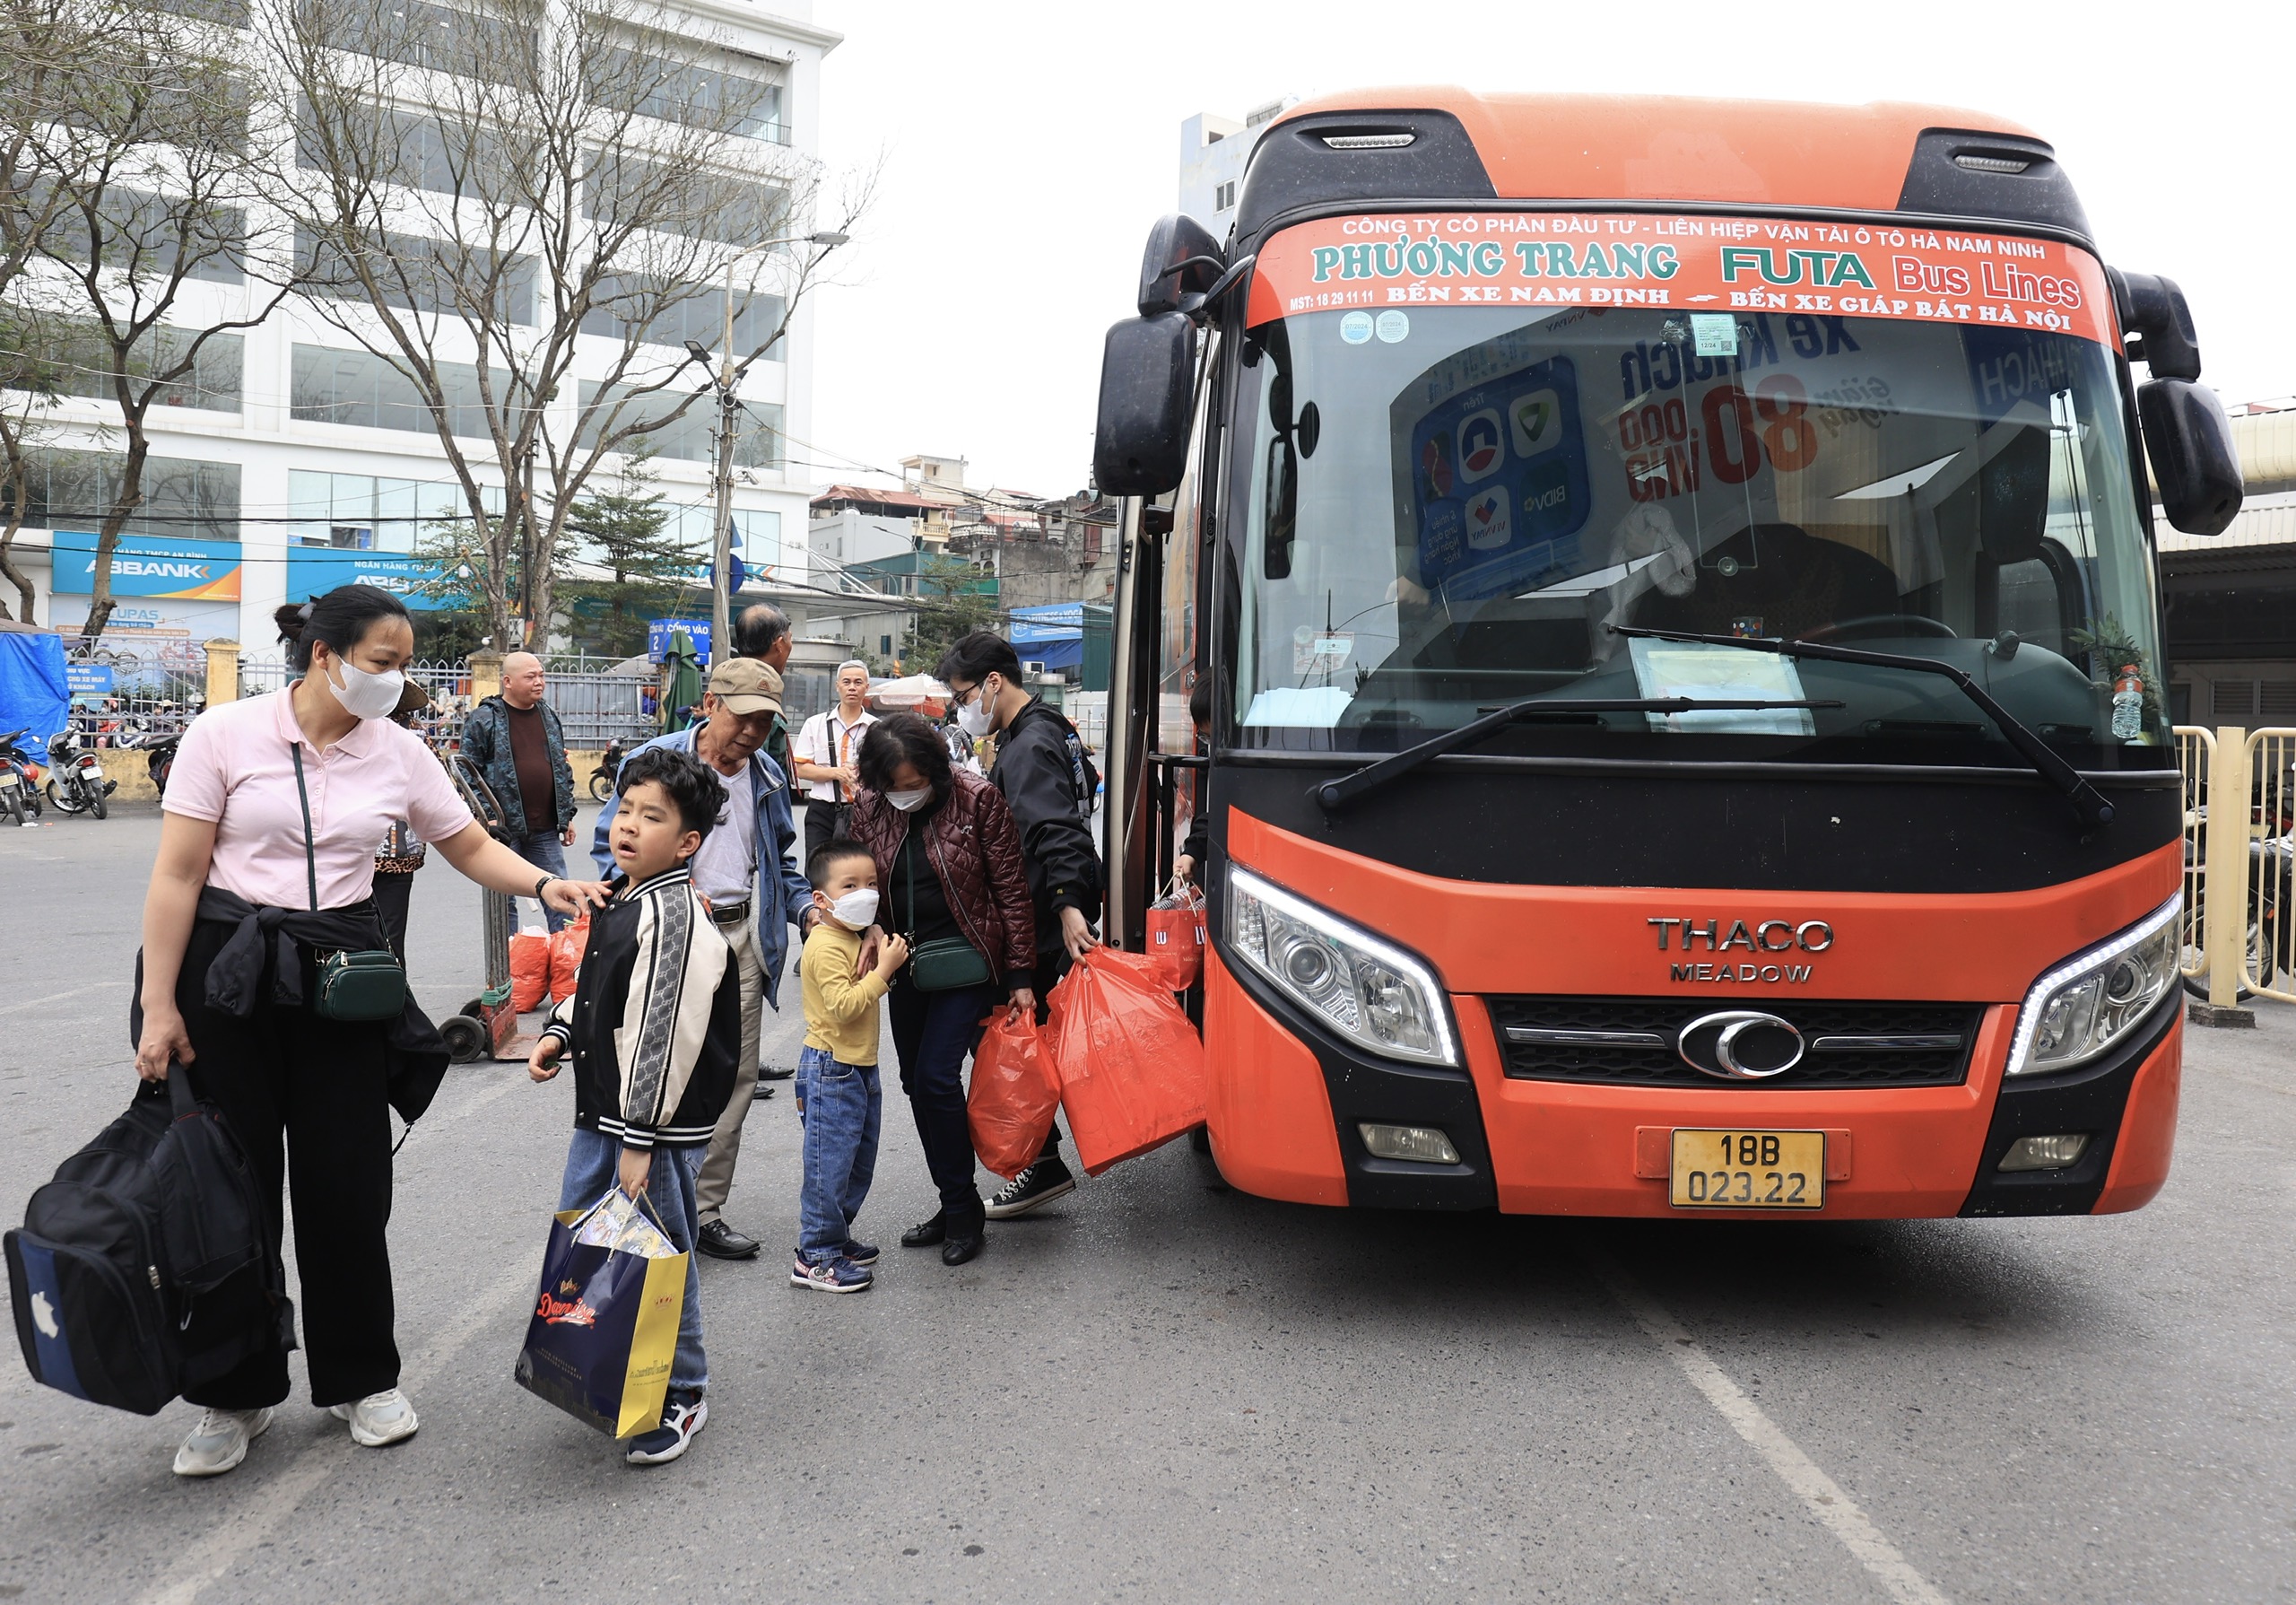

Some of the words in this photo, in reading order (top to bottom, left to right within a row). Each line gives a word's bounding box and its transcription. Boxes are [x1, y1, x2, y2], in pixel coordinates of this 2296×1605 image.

[1343, 217, 1406, 234] CÔNG
[1413, 219, 1441, 233] TY
[1447, 215, 1479, 233] CỔ
[1485, 215, 1545, 233] PHẦN
[1552, 216, 1598, 233] ĐẦU
[1605, 219, 1636, 234] TƯ
[1656, 218, 1703, 236] LIÊN
[1710, 222, 1760, 241] HIỆP
[1764, 224, 1809, 243] VẬN
[1815, 225, 1849, 243] TẢI
[1854, 227, 1871, 245] Ô
[1875, 230, 1905, 248] TÔ
[1910, 231, 1942, 250] HÀ
[1946, 236, 1992, 254] NAM
[1997, 240, 2046, 259] NINH
[1311, 234, 1506, 283] PHƯƠNG
[1514, 240, 1681, 280] TRANG
[1720, 246, 1877, 290] FUTA
[1387, 280, 1451, 302] BẾN
[1459, 286, 1502, 302] XE
[1509, 286, 1582, 302] NAM
[1590, 288, 1670, 307] ĐỊNH
[1892, 255, 1971, 296] Bus
[1980, 261, 2082, 310] Lines
[1290, 295, 1314, 311] MST:
[1316, 293, 1329, 307] 18
[1331, 292, 1344, 305] 29
[1346, 291, 1359, 304] 11
[1361, 290, 1374, 303] 11
[1729, 285, 1787, 309] BẾN
[1794, 294, 1833, 310] XE
[1839, 294, 1909, 315] GIÁP
[1915, 299, 1972, 319] BÁT
[1978, 303, 2018, 323] HÀ
[2024, 309, 2072, 331] NỘI
[354, 561, 381, 571] NGÂN
[383, 561, 409, 571] HÀNG
[117, 609, 159, 620] UPAS
[667, 621, 691, 633] CỔNG
[692, 624, 709, 635] VÀO
[653, 635, 659, 650] 2
[1647, 918, 1835, 952] THACO
[1671, 964, 1813, 983] MEADOW
[1721, 1135, 1780, 1166] 18B
[1688, 1171, 1806, 1203] 023.22
[537, 1293, 596, 1322] Danisa
